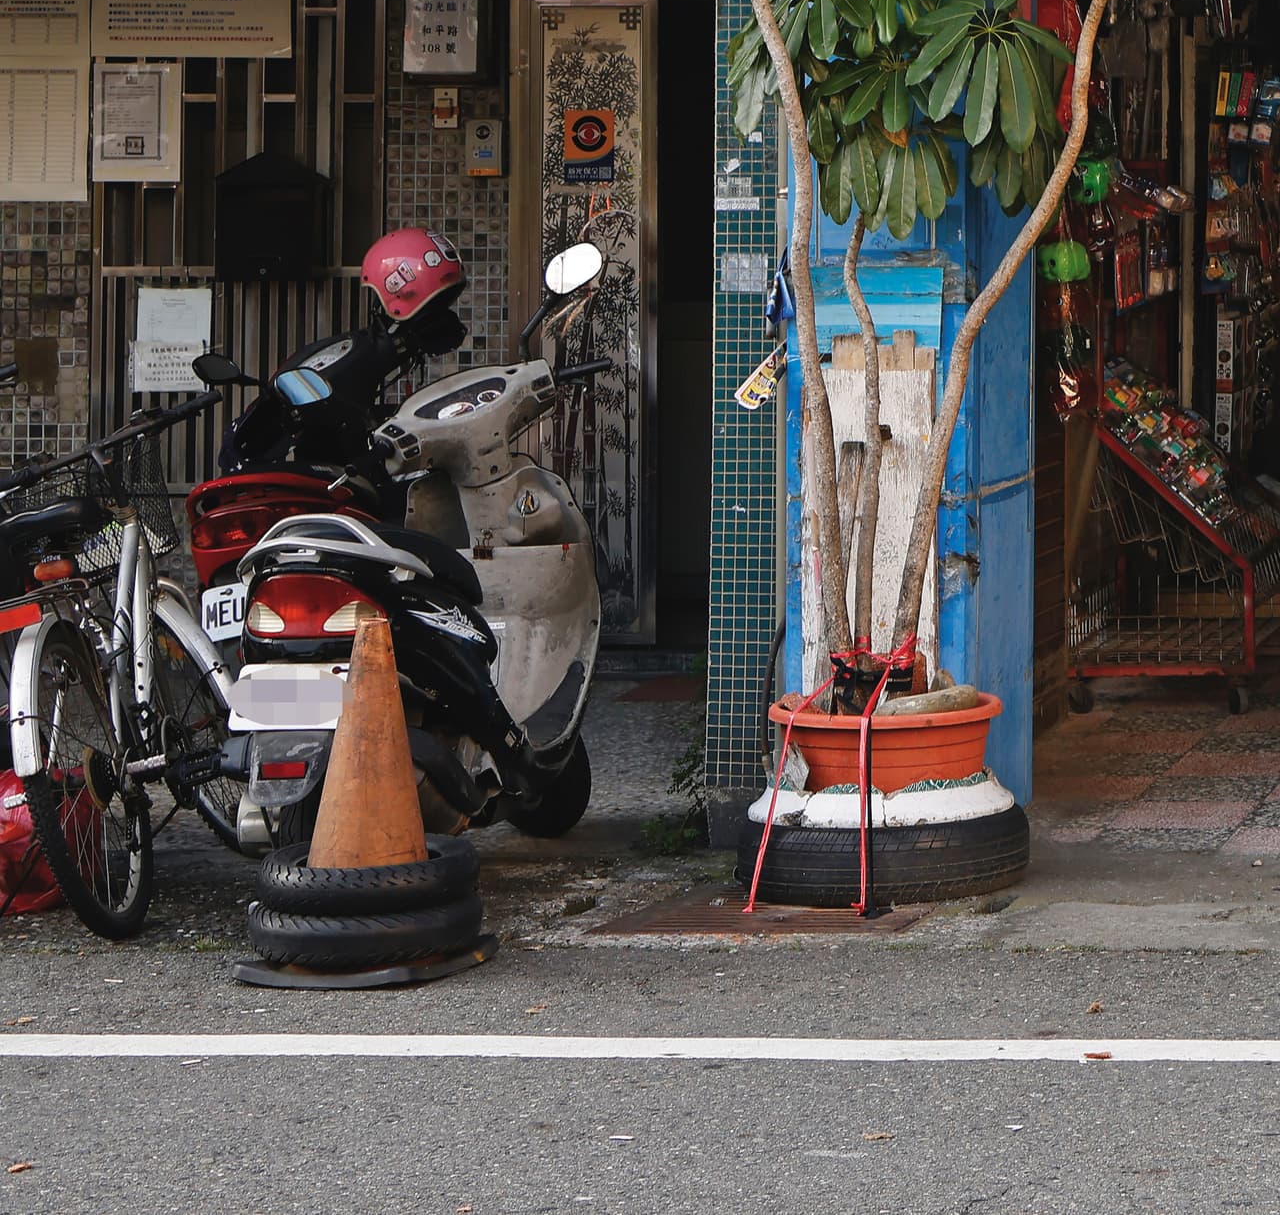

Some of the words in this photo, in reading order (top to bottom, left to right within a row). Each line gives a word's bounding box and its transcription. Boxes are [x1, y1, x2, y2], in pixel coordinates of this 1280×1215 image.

[422, 24, 458, 37] 和平路
[422, 43, 441, 54] 108
[446, 42, 457, 54] 號
[206, 596, 245, 630] MEU
